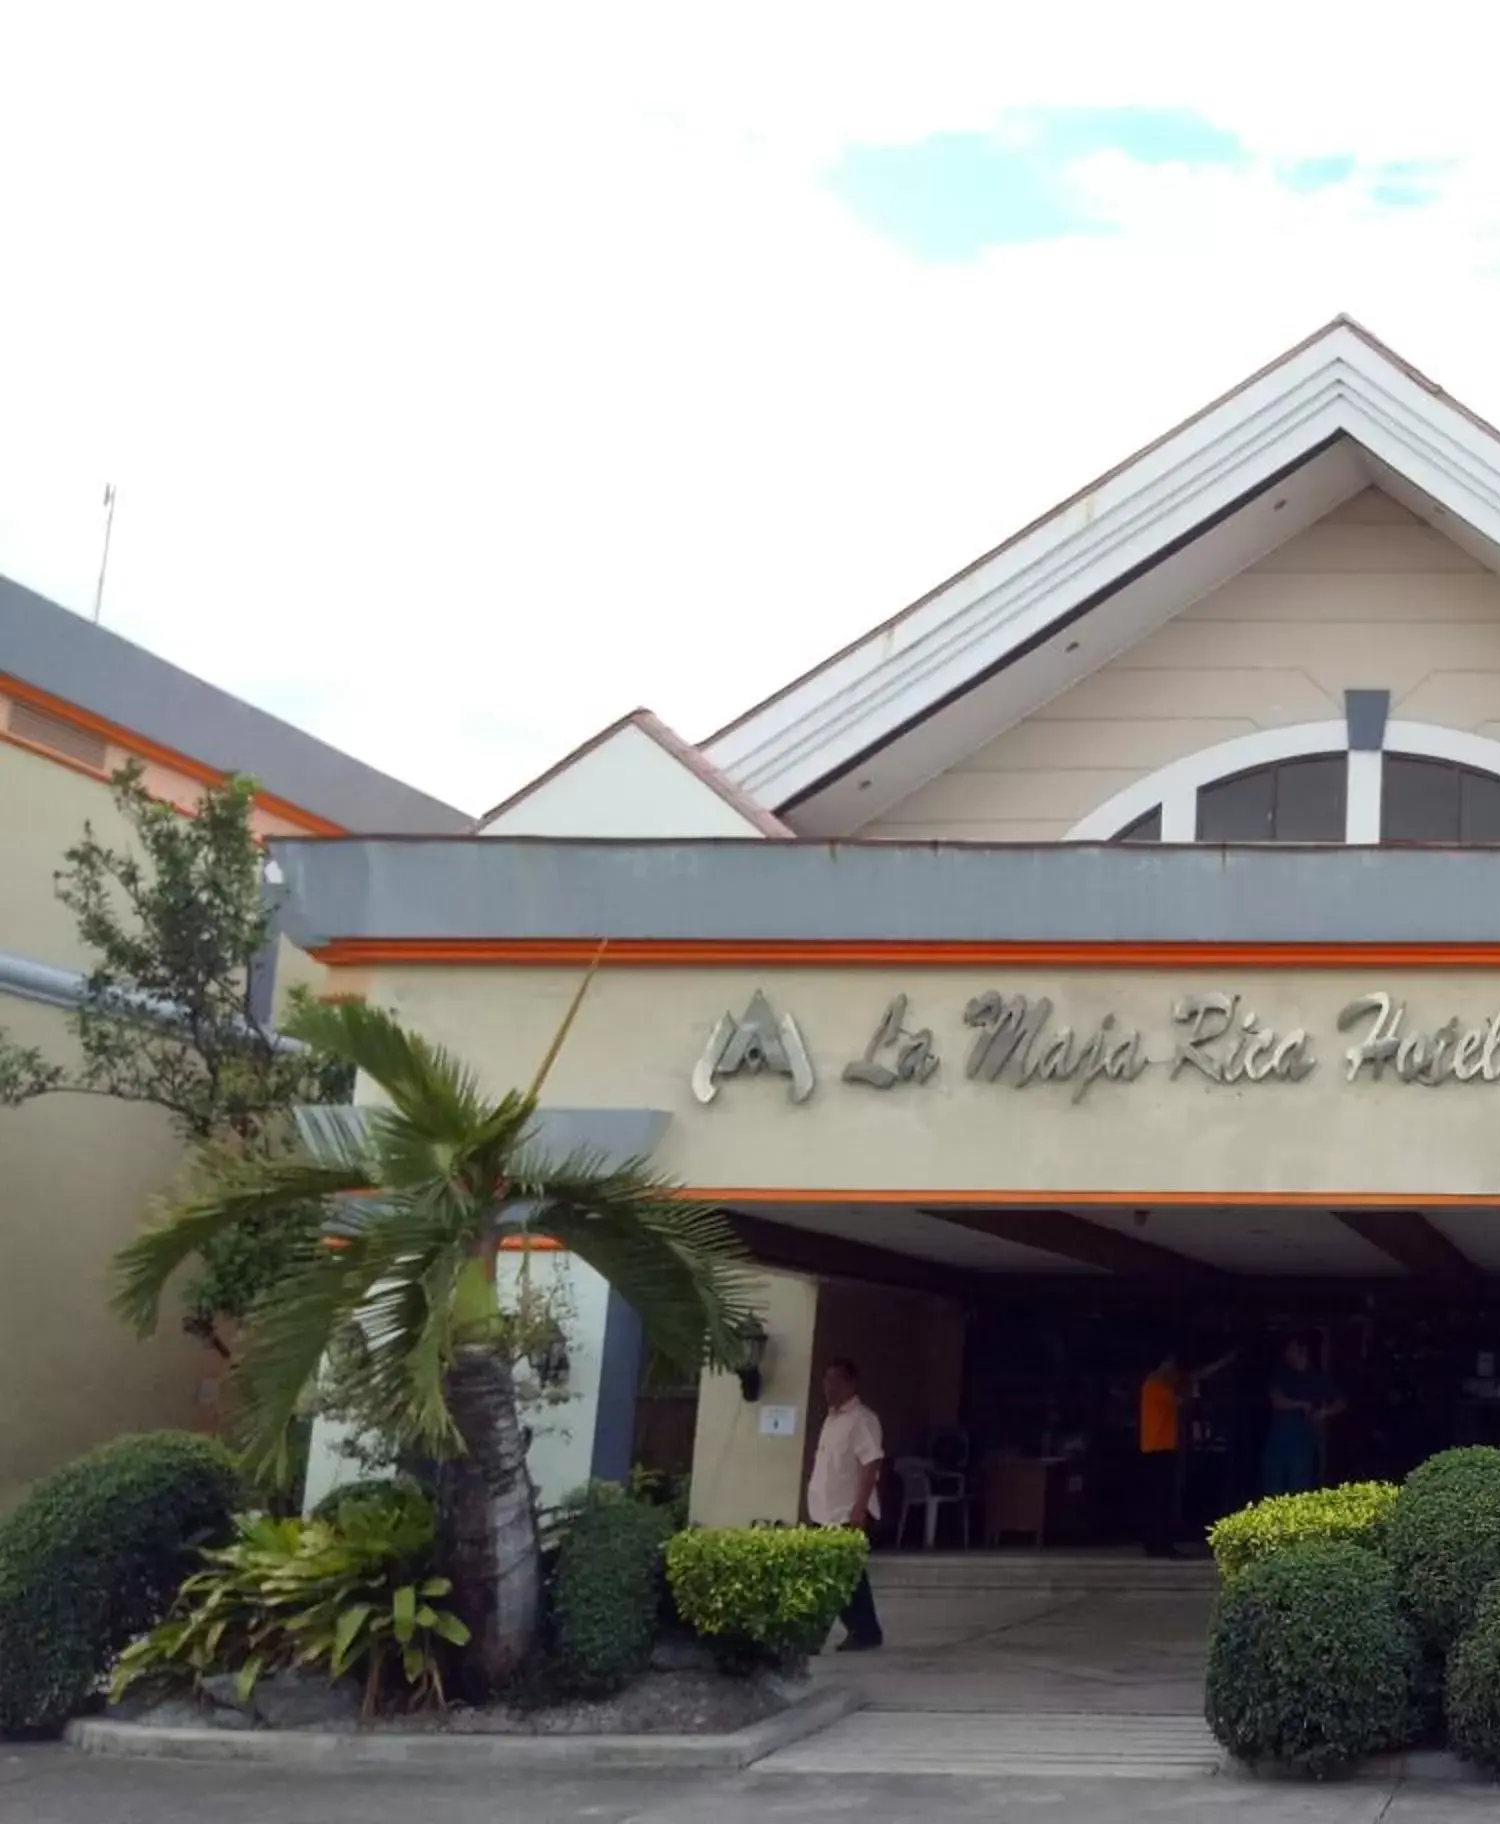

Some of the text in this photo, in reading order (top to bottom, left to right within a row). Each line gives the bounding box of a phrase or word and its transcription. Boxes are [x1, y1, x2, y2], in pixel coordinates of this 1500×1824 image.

[841, 992, 940, 1089] La
[963, 989, 1148, 1105] Maja
[1171, 991, 1316, 1084] Rica
